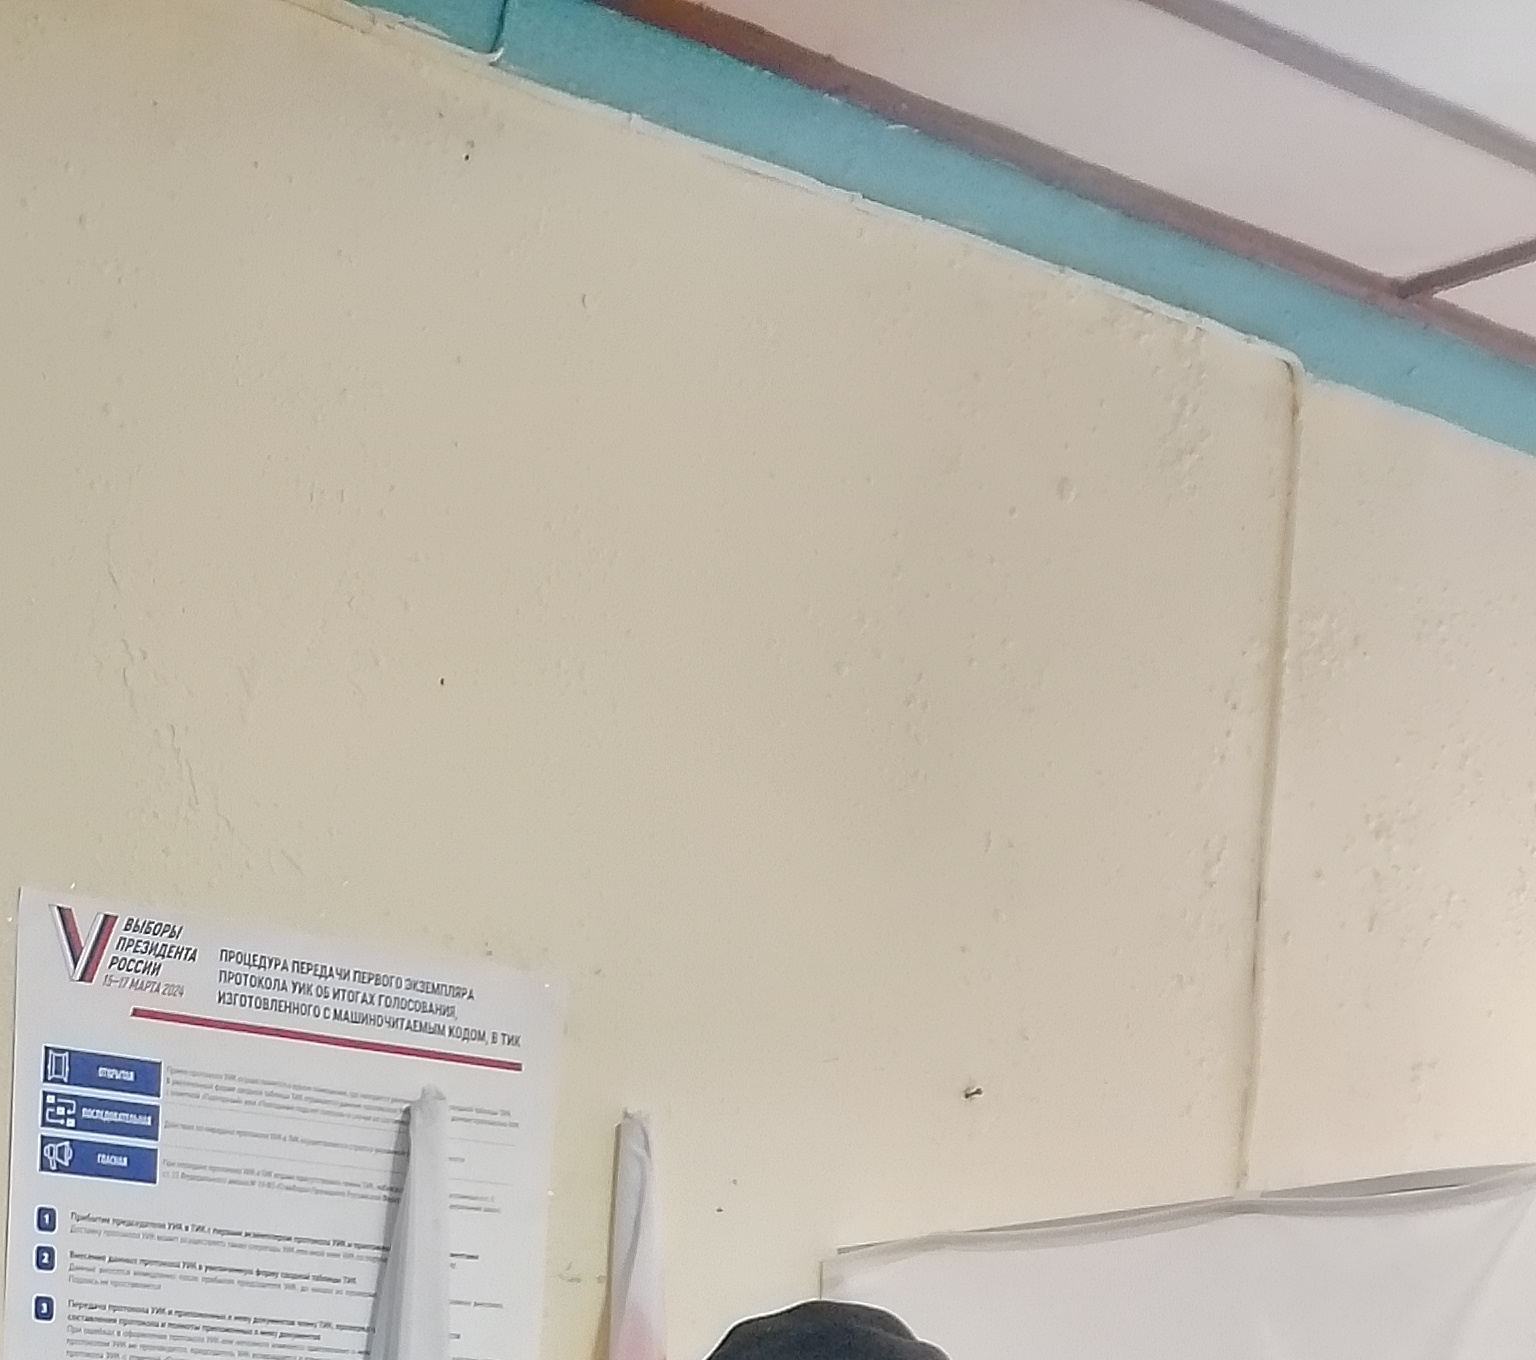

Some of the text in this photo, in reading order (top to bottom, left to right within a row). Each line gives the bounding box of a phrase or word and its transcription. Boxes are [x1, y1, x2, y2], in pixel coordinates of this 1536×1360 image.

[122, 917, 184, 941] ВЫБОРЫ
[114, 936, 199, 963] ПРЕЗИДЕНТА
[108, 955, 163, 978] РОССИИ
[219, 948, 476, 1002] ПРОЦЕДУРА ПЕРЕДАЧИ ПЕРВОГО ЭКЗЕМПЛЯРА
[129, 976, 163, 996] МАРТА
[162, 983, 186, 999] 2024
[218, 969, 459, 1021] ПРОТОКОЛА УИК ОБ ИТОГАХ ГОЛОСОВАНИЯ,
[217, 990, 523, 1048] ИЗГОТОВЛЕННОГО С МАШИНОЧИТАЕМЫМ КОДОМ, В ТИК
